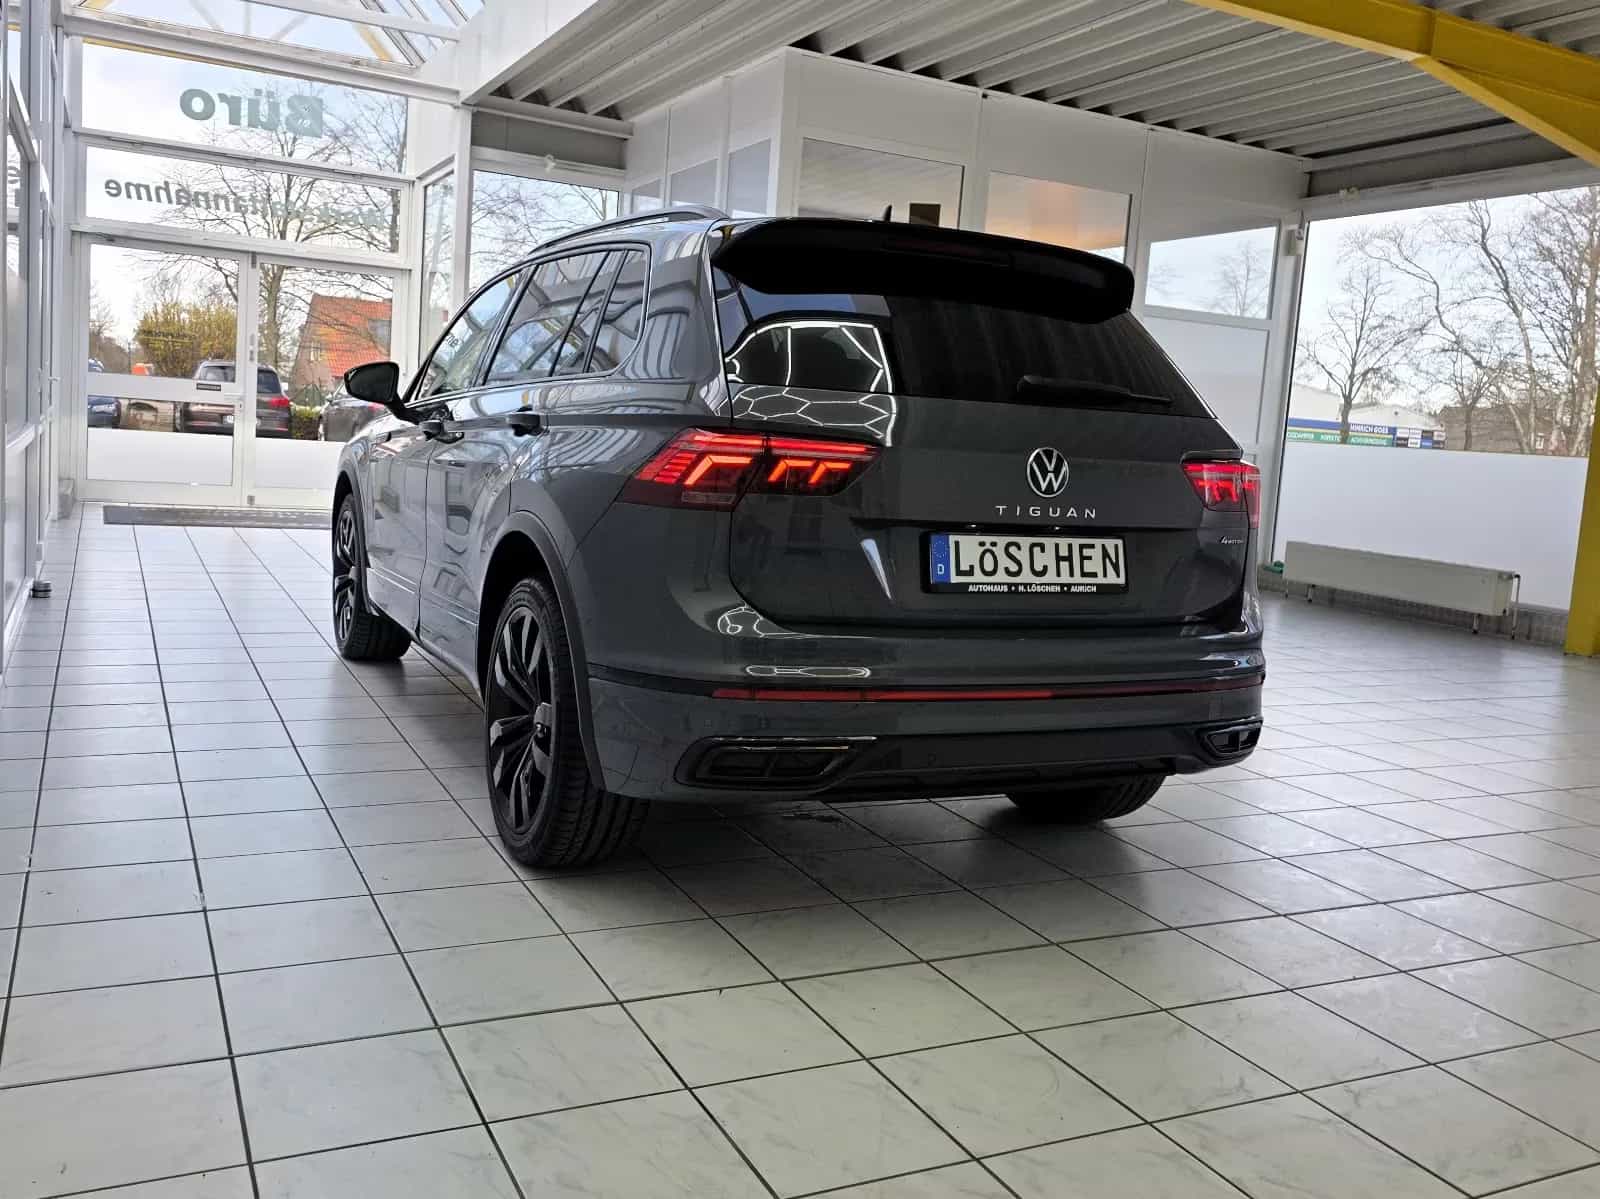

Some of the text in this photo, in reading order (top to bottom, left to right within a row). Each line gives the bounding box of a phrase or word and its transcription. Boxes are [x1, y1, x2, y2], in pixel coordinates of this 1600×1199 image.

[995, 505, 1096, 519] TIGUAN
[937, 563, 945, 575] D
[968, 584, 1009, 593] AUTOHAUS
[1070, 585, 1097, 593] AURICH
